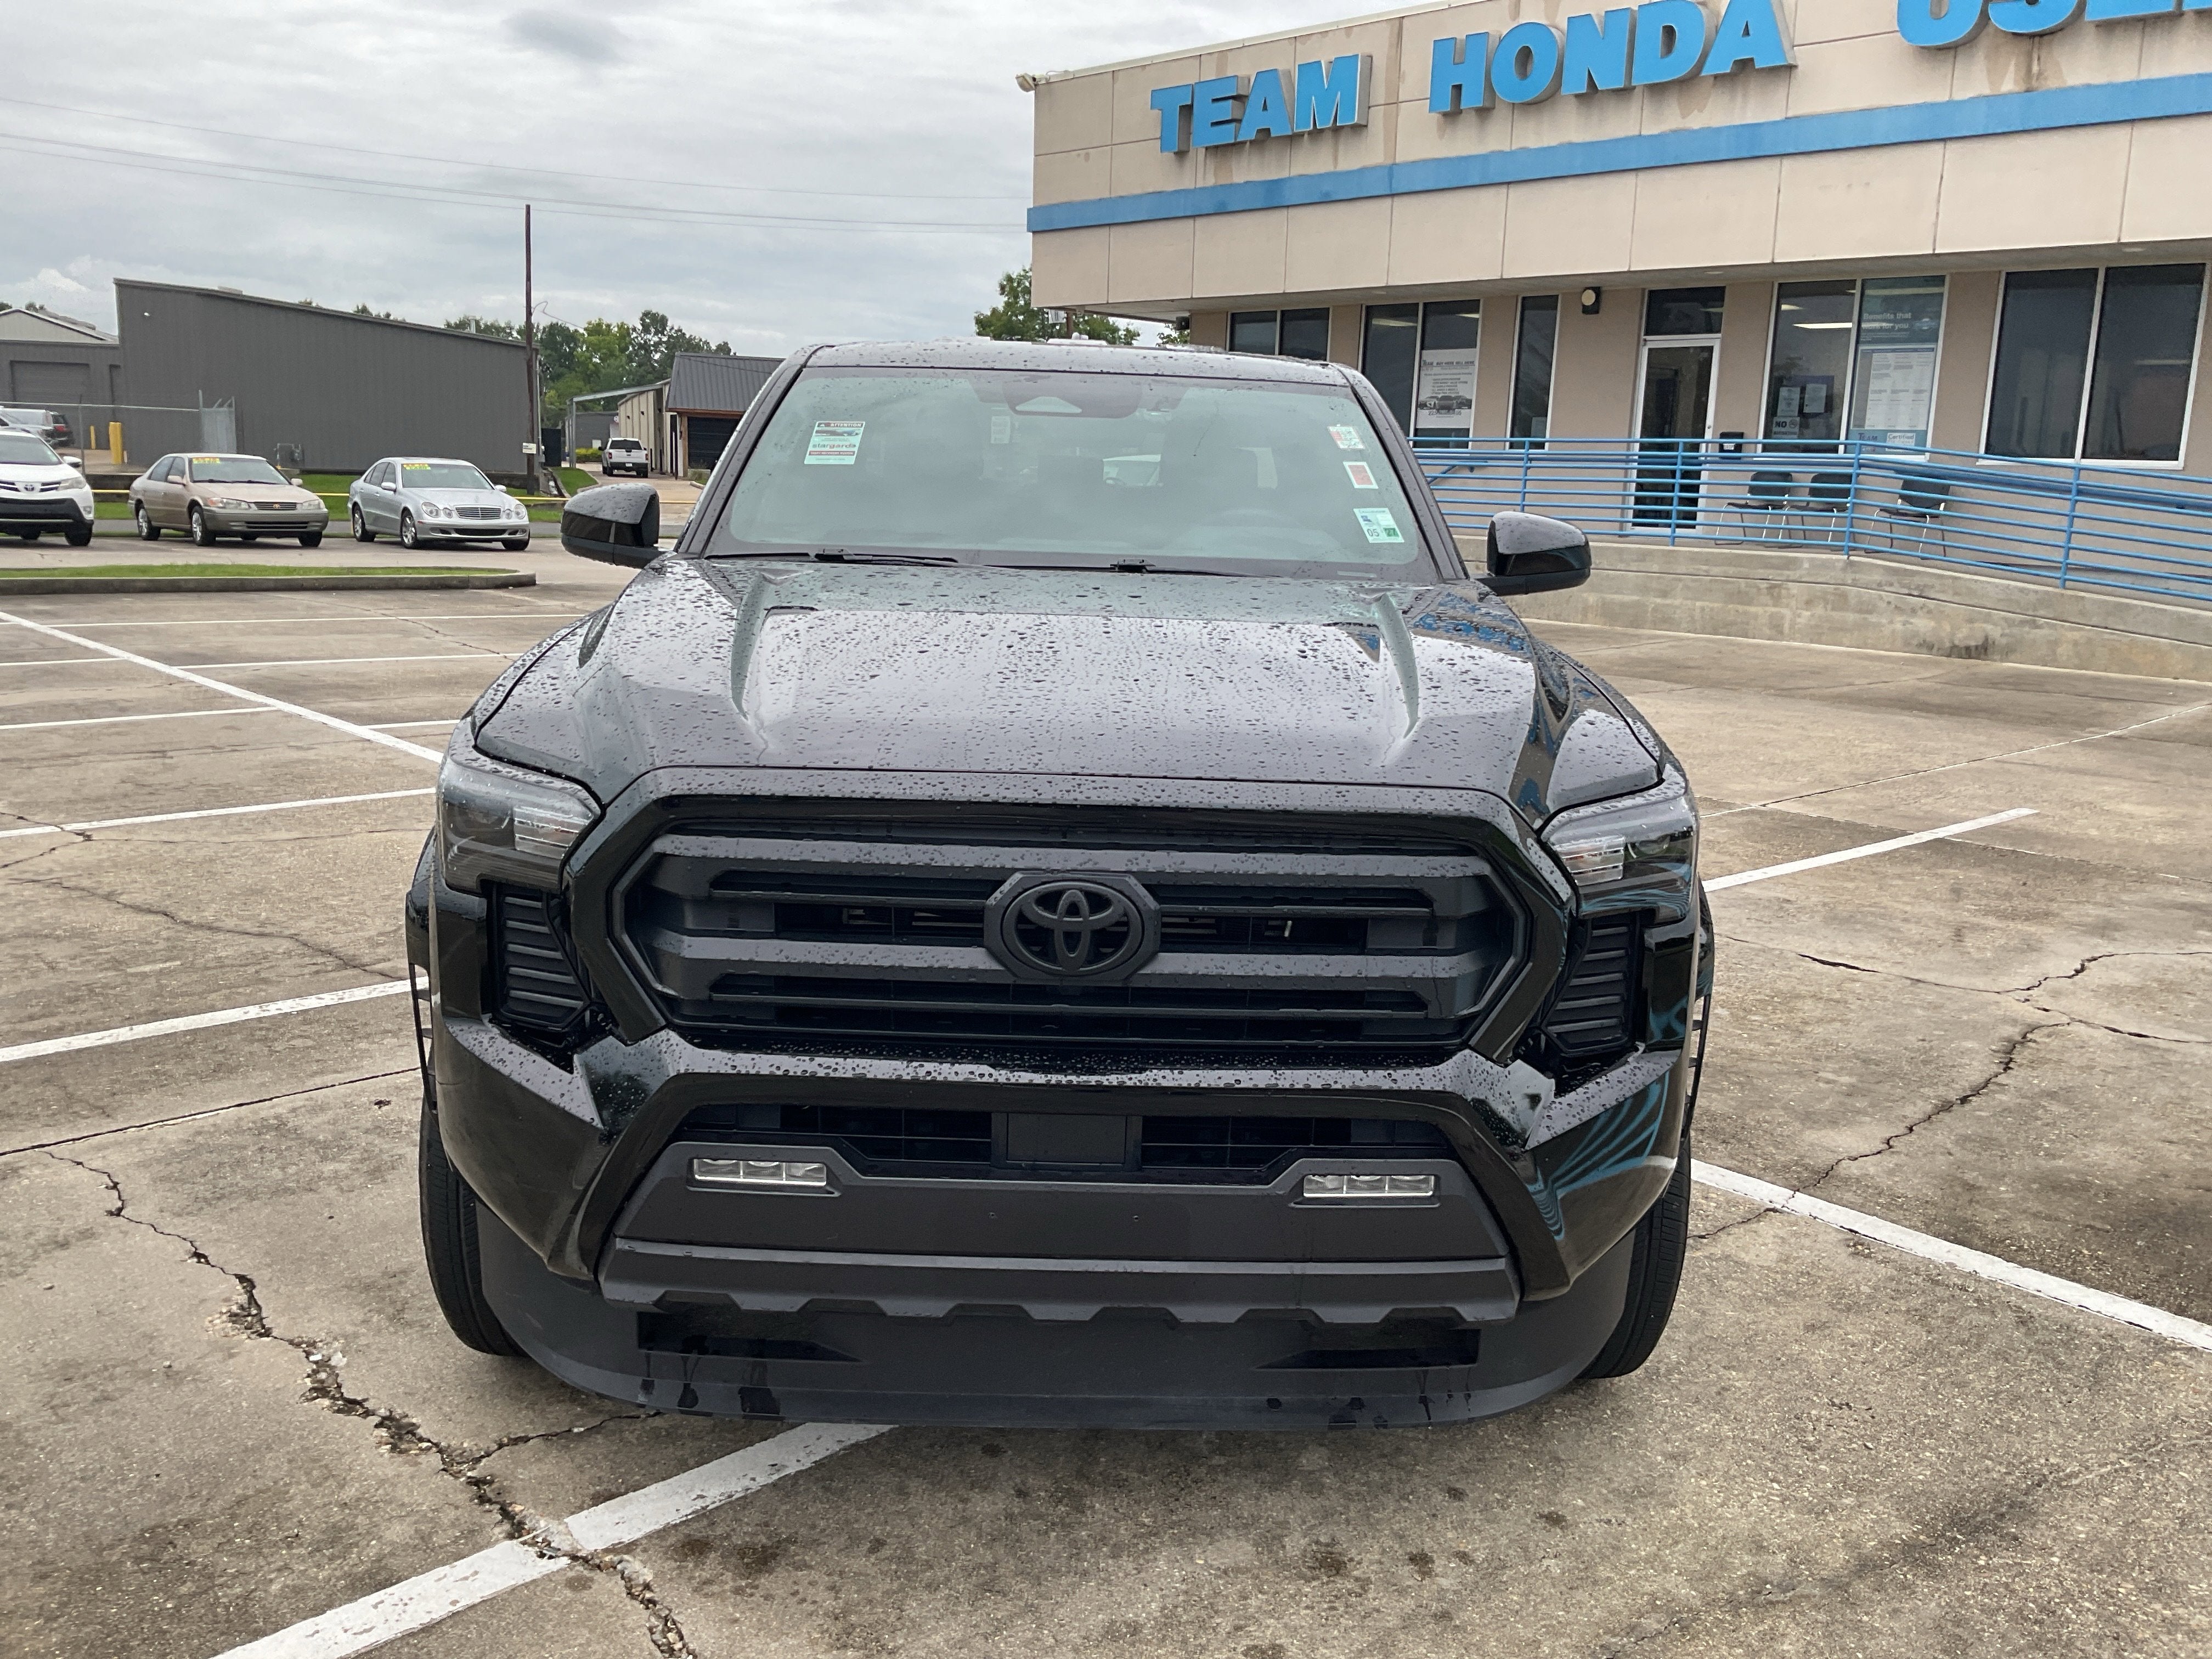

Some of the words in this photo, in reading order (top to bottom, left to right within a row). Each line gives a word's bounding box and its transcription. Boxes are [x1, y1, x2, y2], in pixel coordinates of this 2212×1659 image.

[1151, 54, 1372, 154] TEAM
[1429, 0, 1796, 114] HONDA
[1858, 432, 1877, 441] TEAM
[1367, 528, 1379, 537] 05
[1384, 528, 1396, 536] 27
